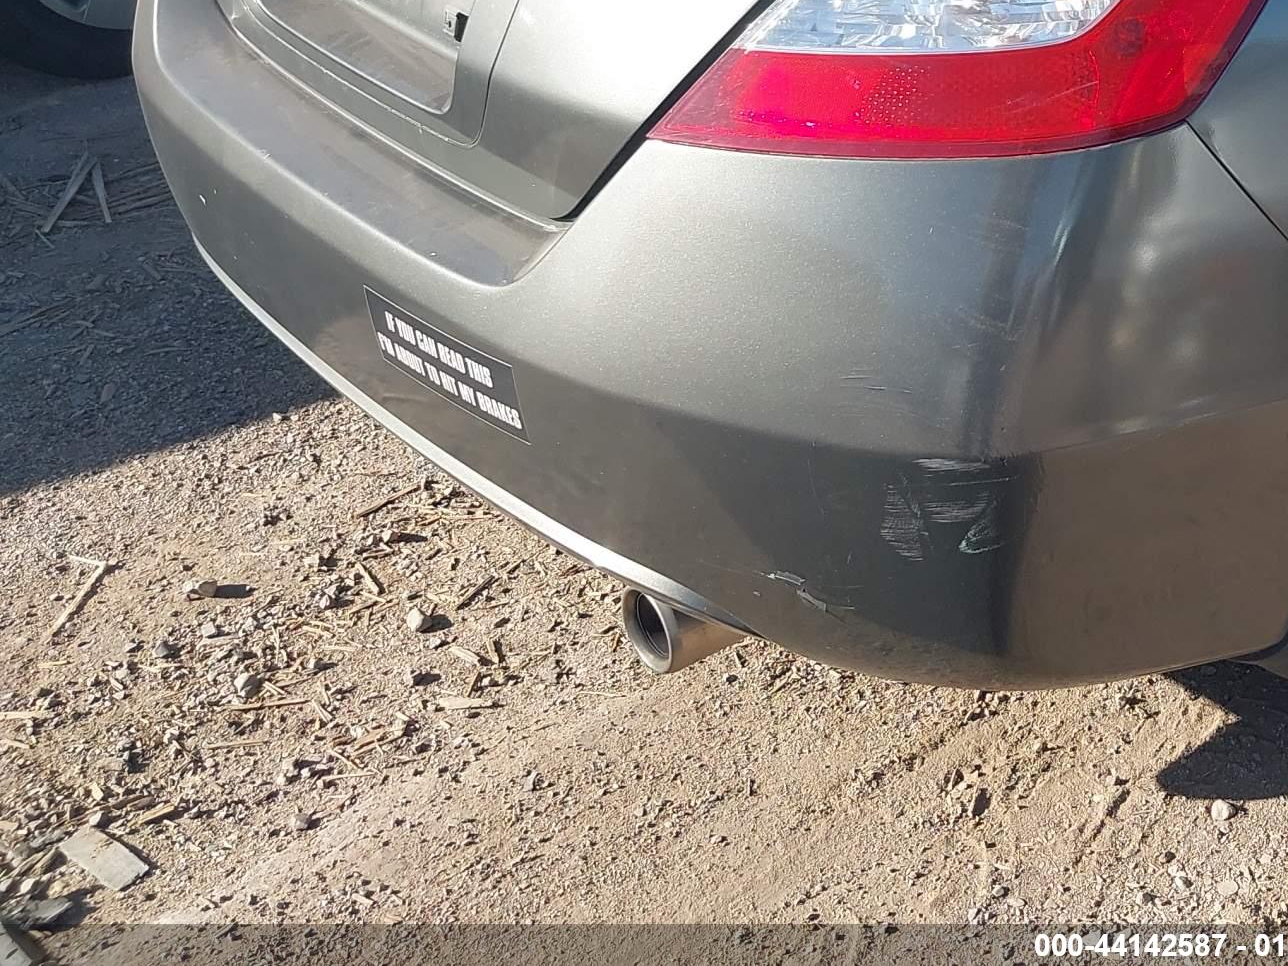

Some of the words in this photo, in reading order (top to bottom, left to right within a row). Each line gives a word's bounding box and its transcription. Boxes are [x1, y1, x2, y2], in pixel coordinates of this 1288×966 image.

[384, 310, 395, 333] IF
[394, 316, 416, 346] YOU
[415, 329, 438, 359] CAN
[436, 342, 466, 374] READ
[464, 357, 493, 388] THIS
[393, 342, 426, 377] ABOUT
[424, 361, 441, 386] TO
[439, 370, 459, 397] HIT
[457, 381, 477, 407] MY
[475, 391, 523, 430] BRAKES
